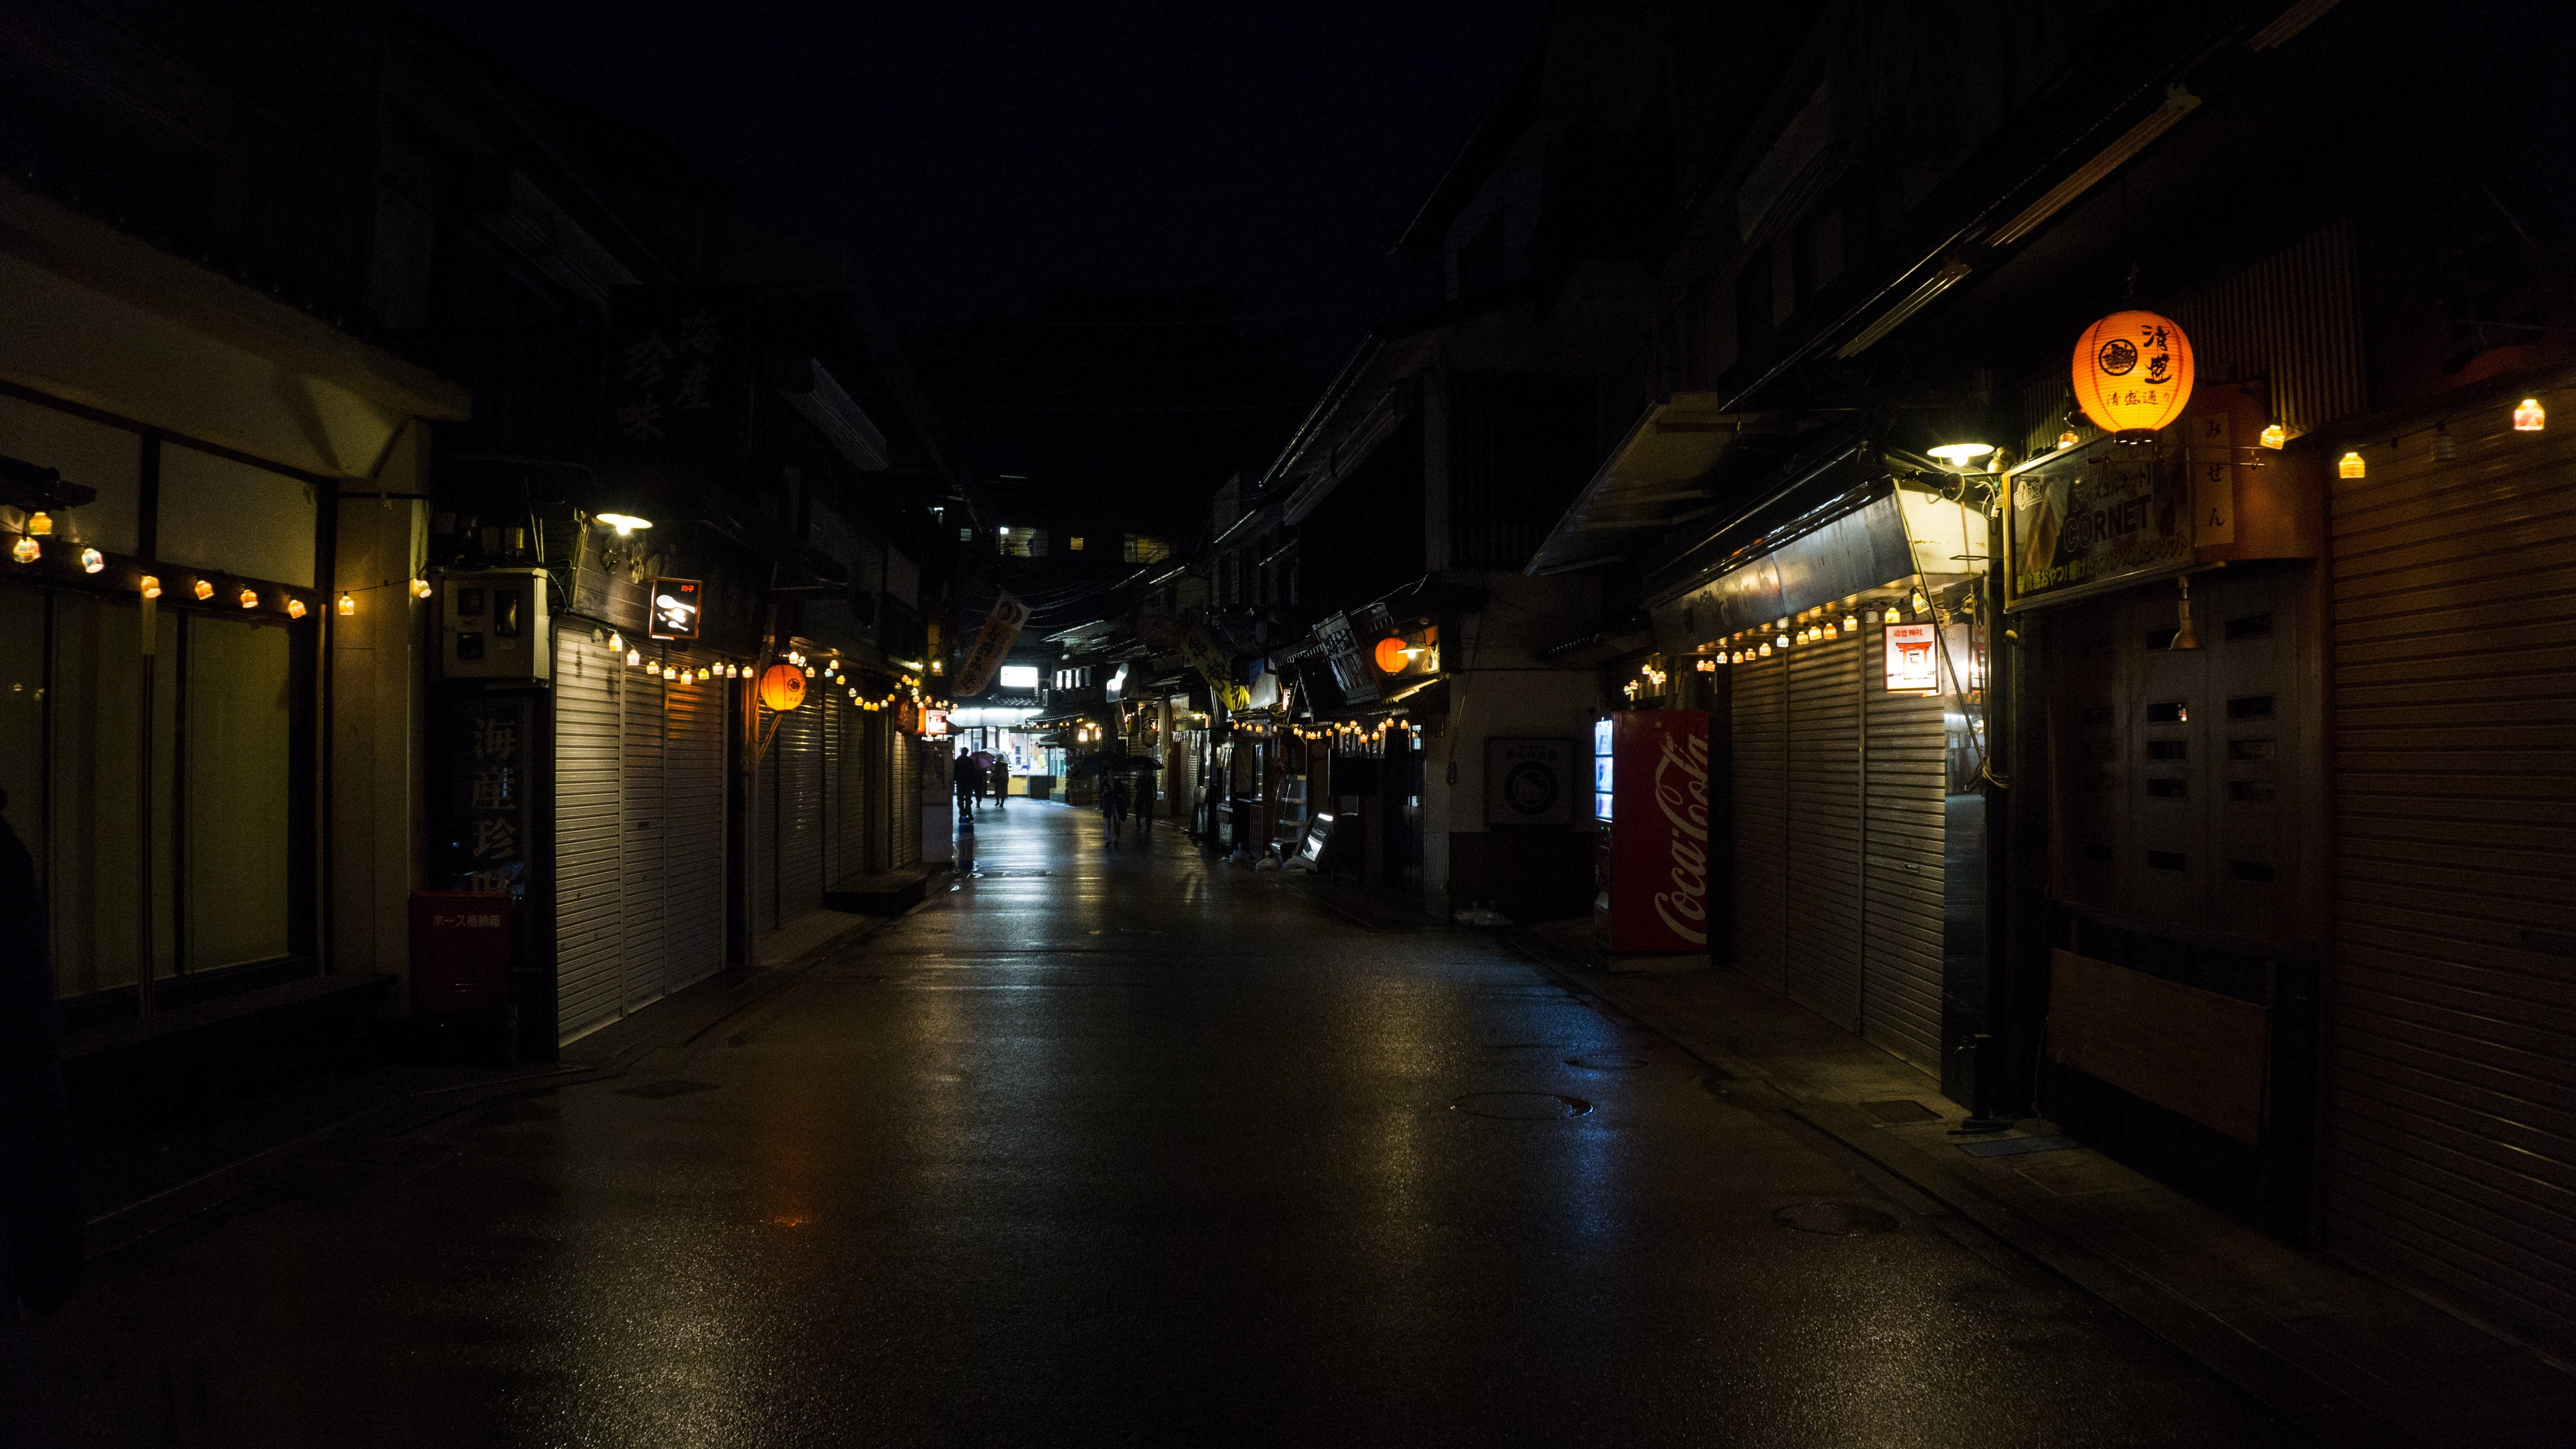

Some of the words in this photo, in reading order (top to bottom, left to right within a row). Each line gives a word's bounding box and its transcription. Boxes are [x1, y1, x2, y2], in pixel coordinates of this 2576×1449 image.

[2106, 390, 2170, 406] 清盛通り
[2205, 420, 2225, 527] みせん
[2063, 493, 2151, 553] CORNET
[432, 914, 501, 928] ホース格納箱
